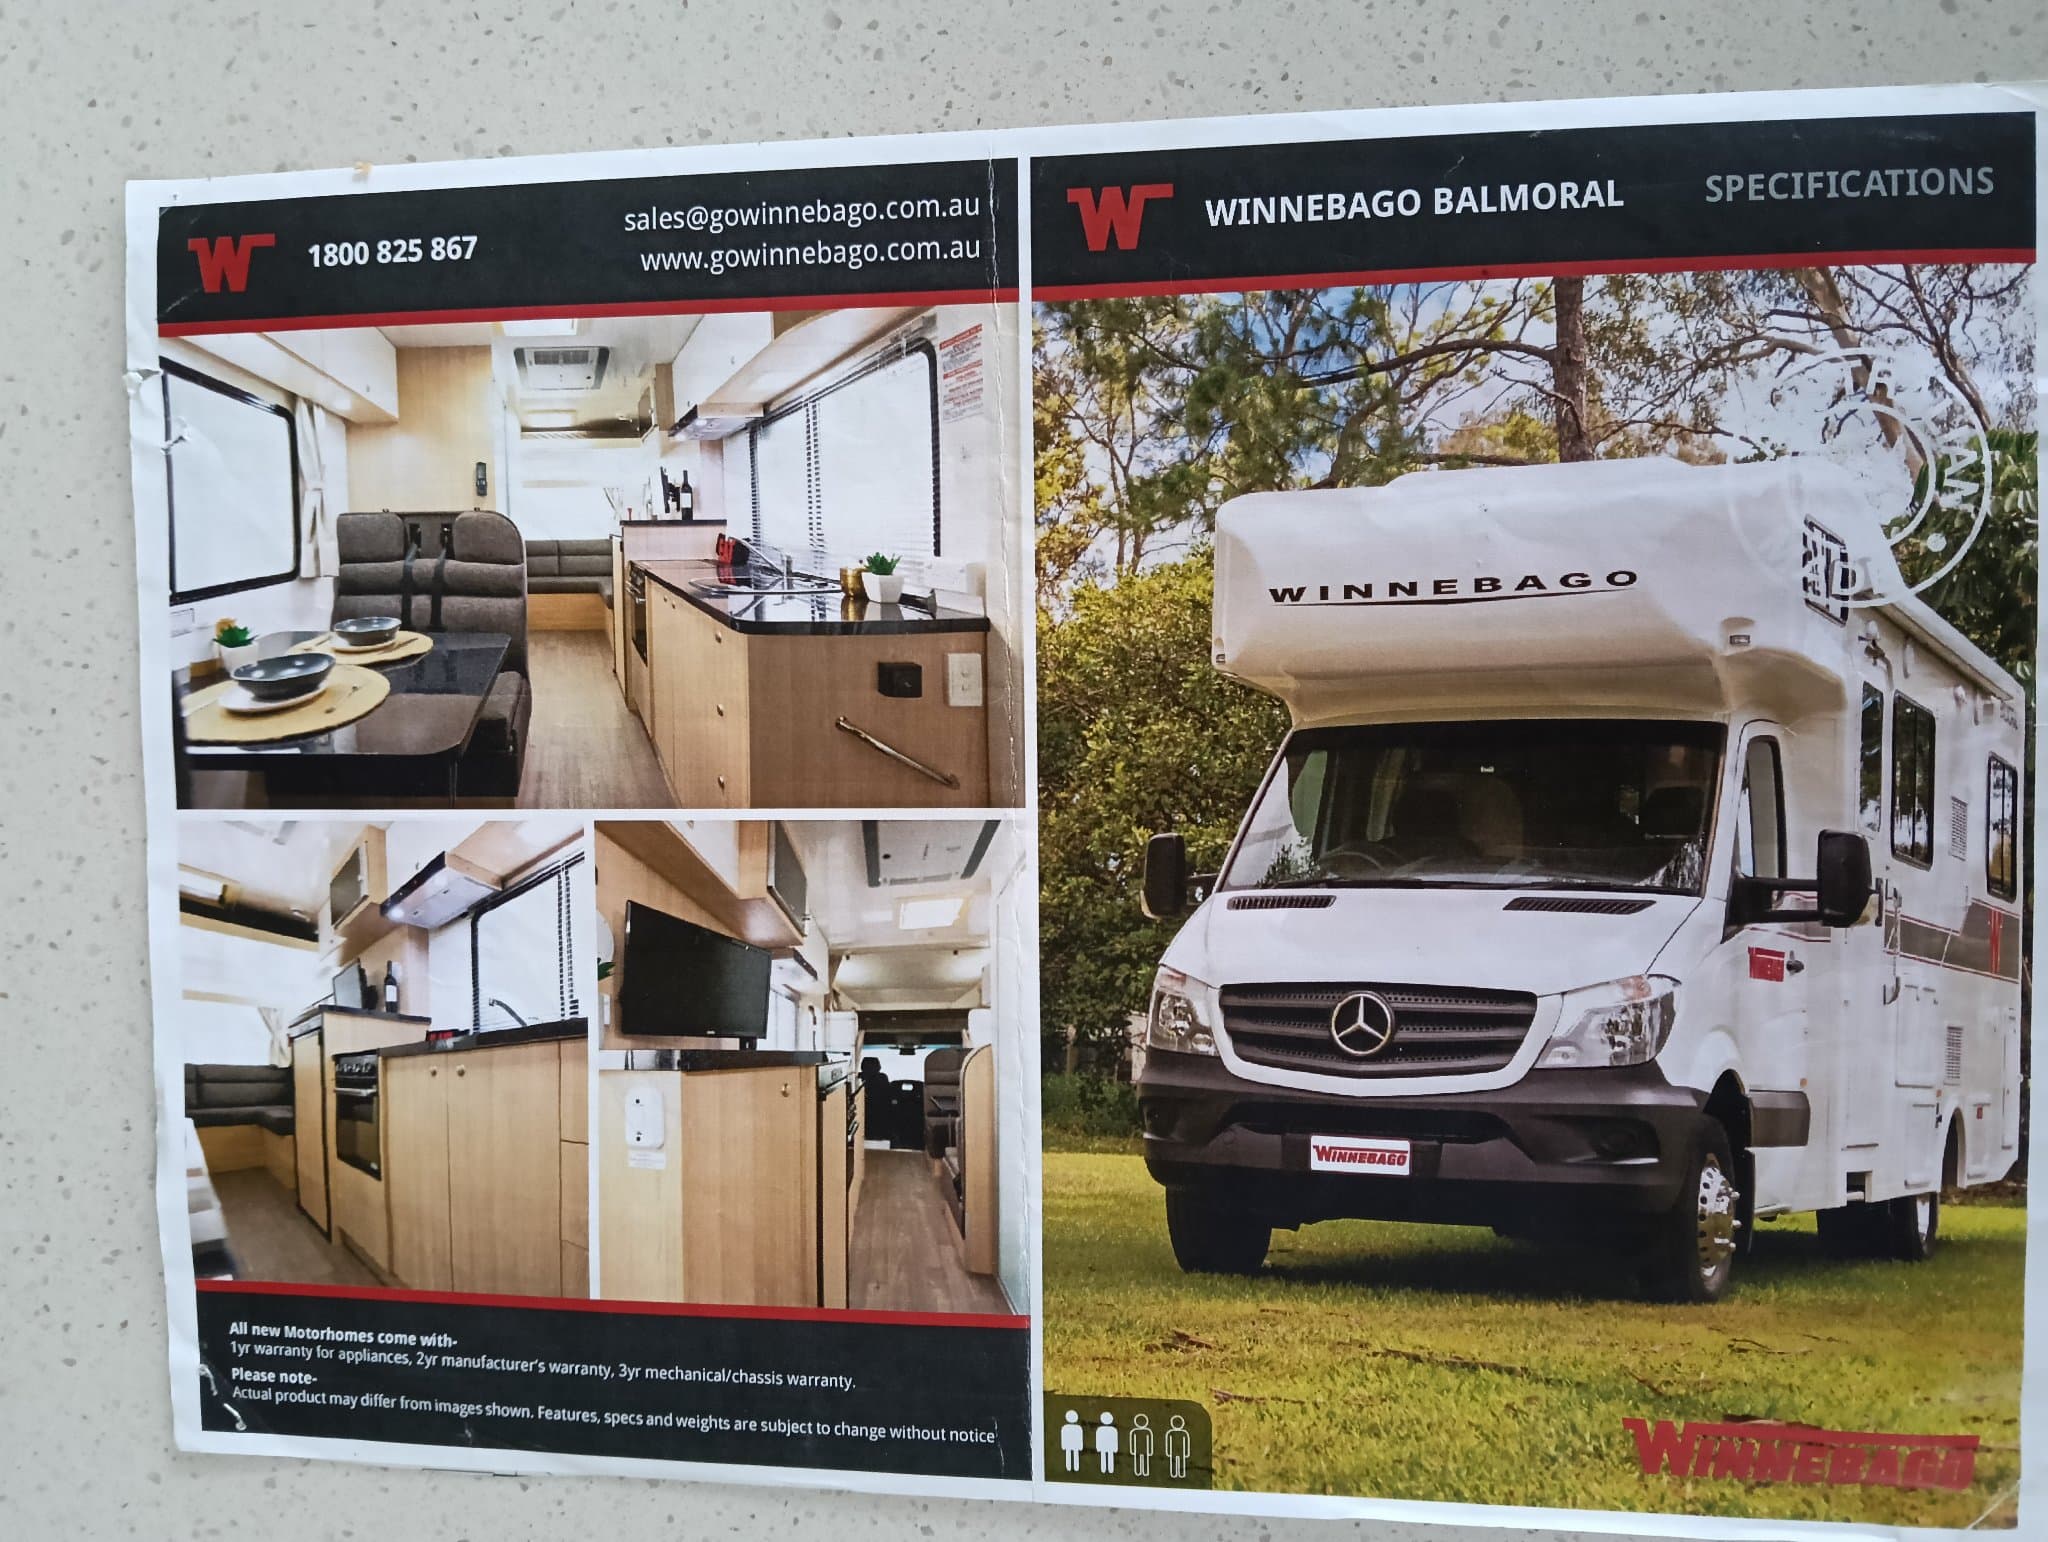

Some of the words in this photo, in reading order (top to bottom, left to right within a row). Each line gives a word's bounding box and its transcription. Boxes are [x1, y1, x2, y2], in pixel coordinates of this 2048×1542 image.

[1205, 190, 1421, 227] WINNEBAGO
[1434, 179, 1625, 216] BALMORAL
[1705, 165, 1995, 203] SPECIFICATIONS
[624, 194, 980, 234] sales@gowinnebago.com.au
[308, 241, 370, 268] 1800
[376, 238, 423, 264] 825
[430, 235, 478, 261] 867
[640, 237, 981, 275] www.gowinnebago.com.au
[1268, 570, 1638, 603] WINNEBAGO
[1312, 1145, 1409, 1167] WINNEBAGO
[229, 1321, 248, 1335] All
[251, 1325, 281, 1337] new
[284, 1325, 375, 1344] Motorhomes
[377, 1332, 417, 1346] come
[419, 1332, 458, 1348] with-
[230, 1340, 251, 1358] 1yr
[253, 1344, 313, 1361] warranty
[316, 1344, 335, 1359] for
[338, 1348, 413, 1366] appliances,
[416, 1351, 439, 1369] 2yr
[548, 1362, 615, 1380] warranty,
[618, 1363, 642, 1382] 3yr
[645, 1365, 784, 1385] mechanical/chassis
[786, 1374, 856, 1392] warranty.
[231, 1367, 276, 1383] Please
[279, 1372, 318, 1385] note-
[232, 1386, 272, 1401] Actual
[275, 1389, 327, 1405] product
[329, 1394, 359, 1410] may
[360, 1392, 397, 1409] differ
[399, 1395, 432, 1411] from
[434, 1399, 483, 1418] images
[484, 1401, 534, 1419] shown.
[537, 1405, 601, 1424] Features,
[603, 1412, 644, 1428] specs
[645, 1412, 673, 1427] and
[675, 1414, 731, 1433] weights
[733, 1419, 758, 1432] are
[760, 1418, 813, 1437] subject
[816, 1422, 831, 1435] to
[834, 1421, 886, 1442] change
[889, 1424, 947, 1441] without
[949, 1427, 995, 1444] notice
[1622, 1417, 1981, 1492] WINNEBAGO
